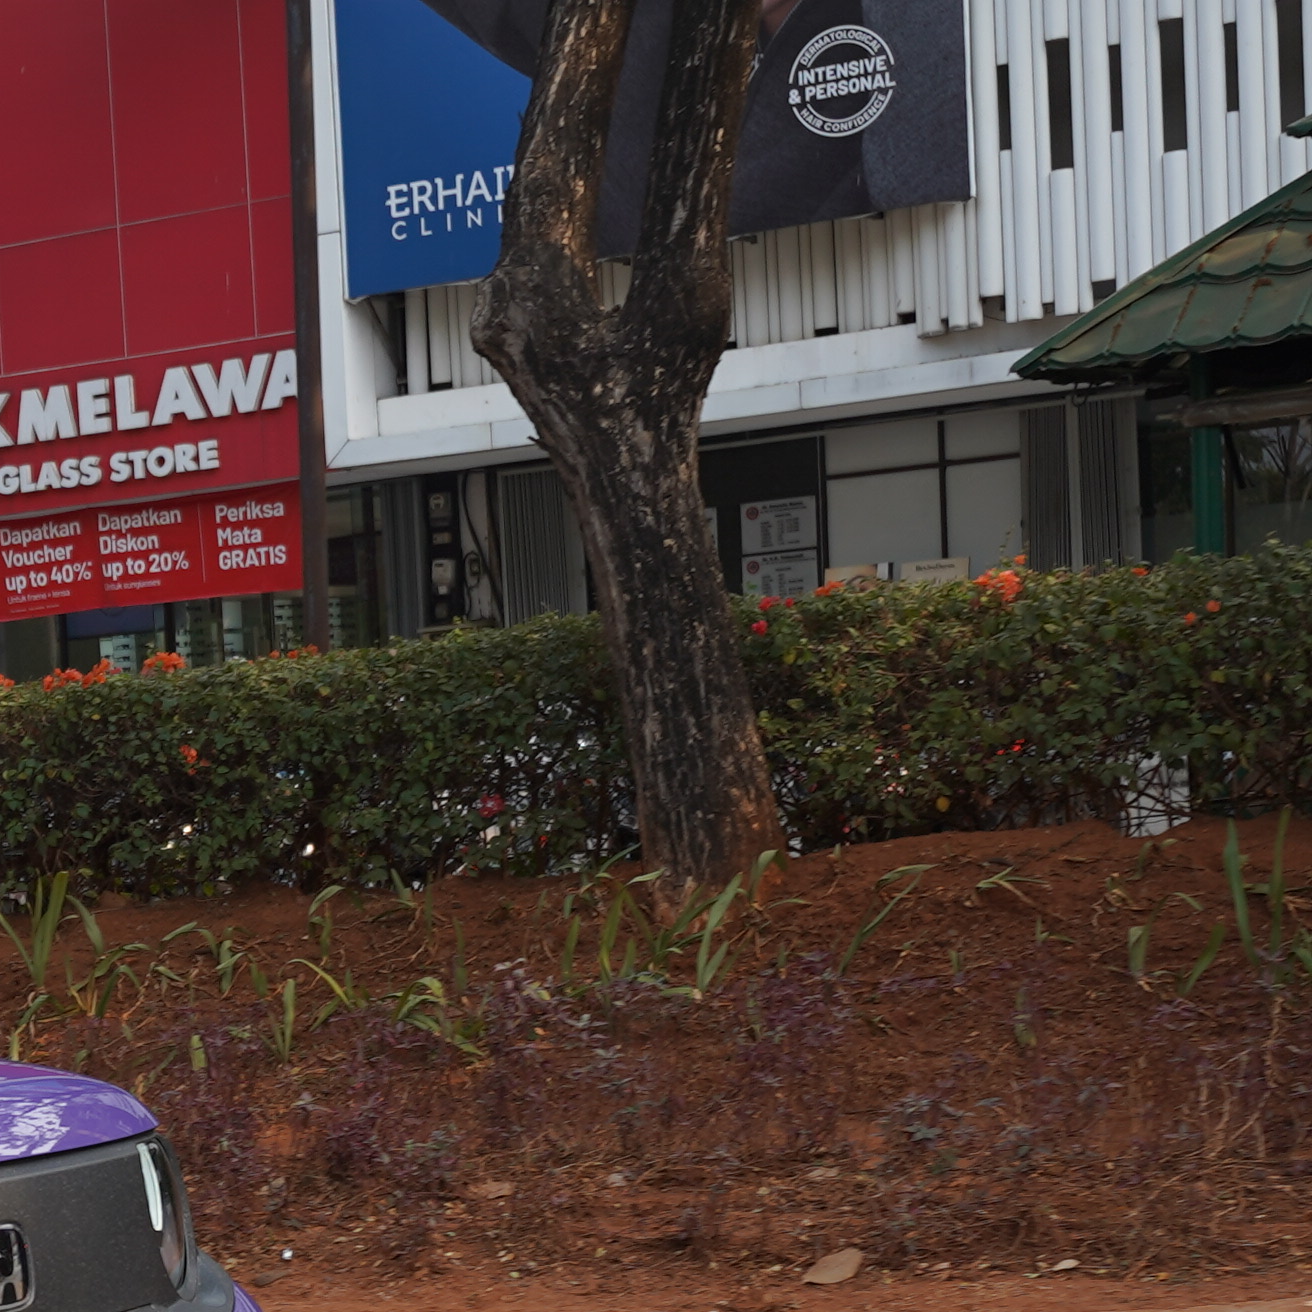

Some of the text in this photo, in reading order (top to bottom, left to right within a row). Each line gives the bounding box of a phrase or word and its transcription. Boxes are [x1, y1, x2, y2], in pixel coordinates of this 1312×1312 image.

[799, 30, 882, 66] DERMATOLOGICAL
[798, 54, 888, 86] INTENSIVE
[788, 72, 897, 105] & PERSONAL
[799, 93, 887, 132] HAIR CONFIDENCE
[391, 204, 503, 240] CLINI
[110, 439, 220, 482] STORE
[97, 507, 182, 533] Dapatkan
[214, 500, 285, 524] Periksa
[0, 520, 81, 547] Dapatkan
[99, 534, 159, 555] Diskon
[216, 526, 262, 547] Mata
[2, 544, 74, 568] Voucher
[102, 550, 189, 581] up to 20%
[218, 545, 287, 571] GRATIS
[5, 575, 27, 594] up
[29, 569, 48, 588] to
